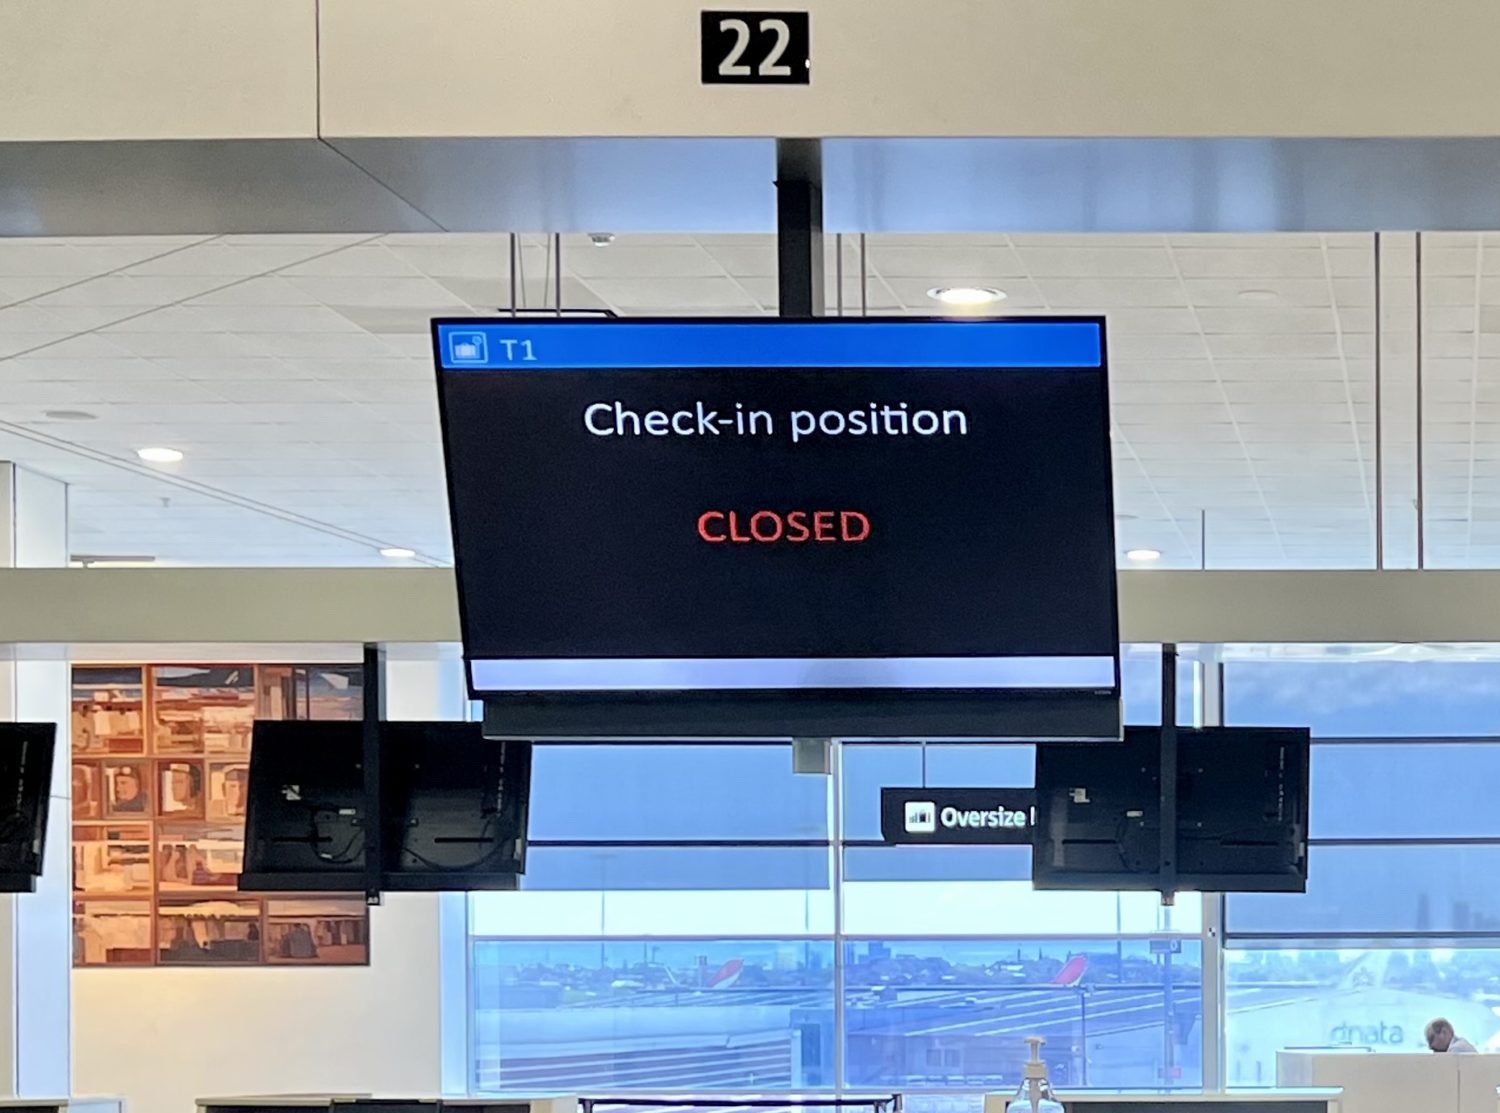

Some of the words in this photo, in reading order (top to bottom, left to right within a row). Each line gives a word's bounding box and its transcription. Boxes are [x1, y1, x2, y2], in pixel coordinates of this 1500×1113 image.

[718, 18, 791, 76] 22
[500, 339, 537, 361] T1
[584, 401, 773, 436] Check-in
[791, 402, 968, 442] position
[697, 510, 871, 543] CLOSED
[940, 806, 1026, 828] Oversize
